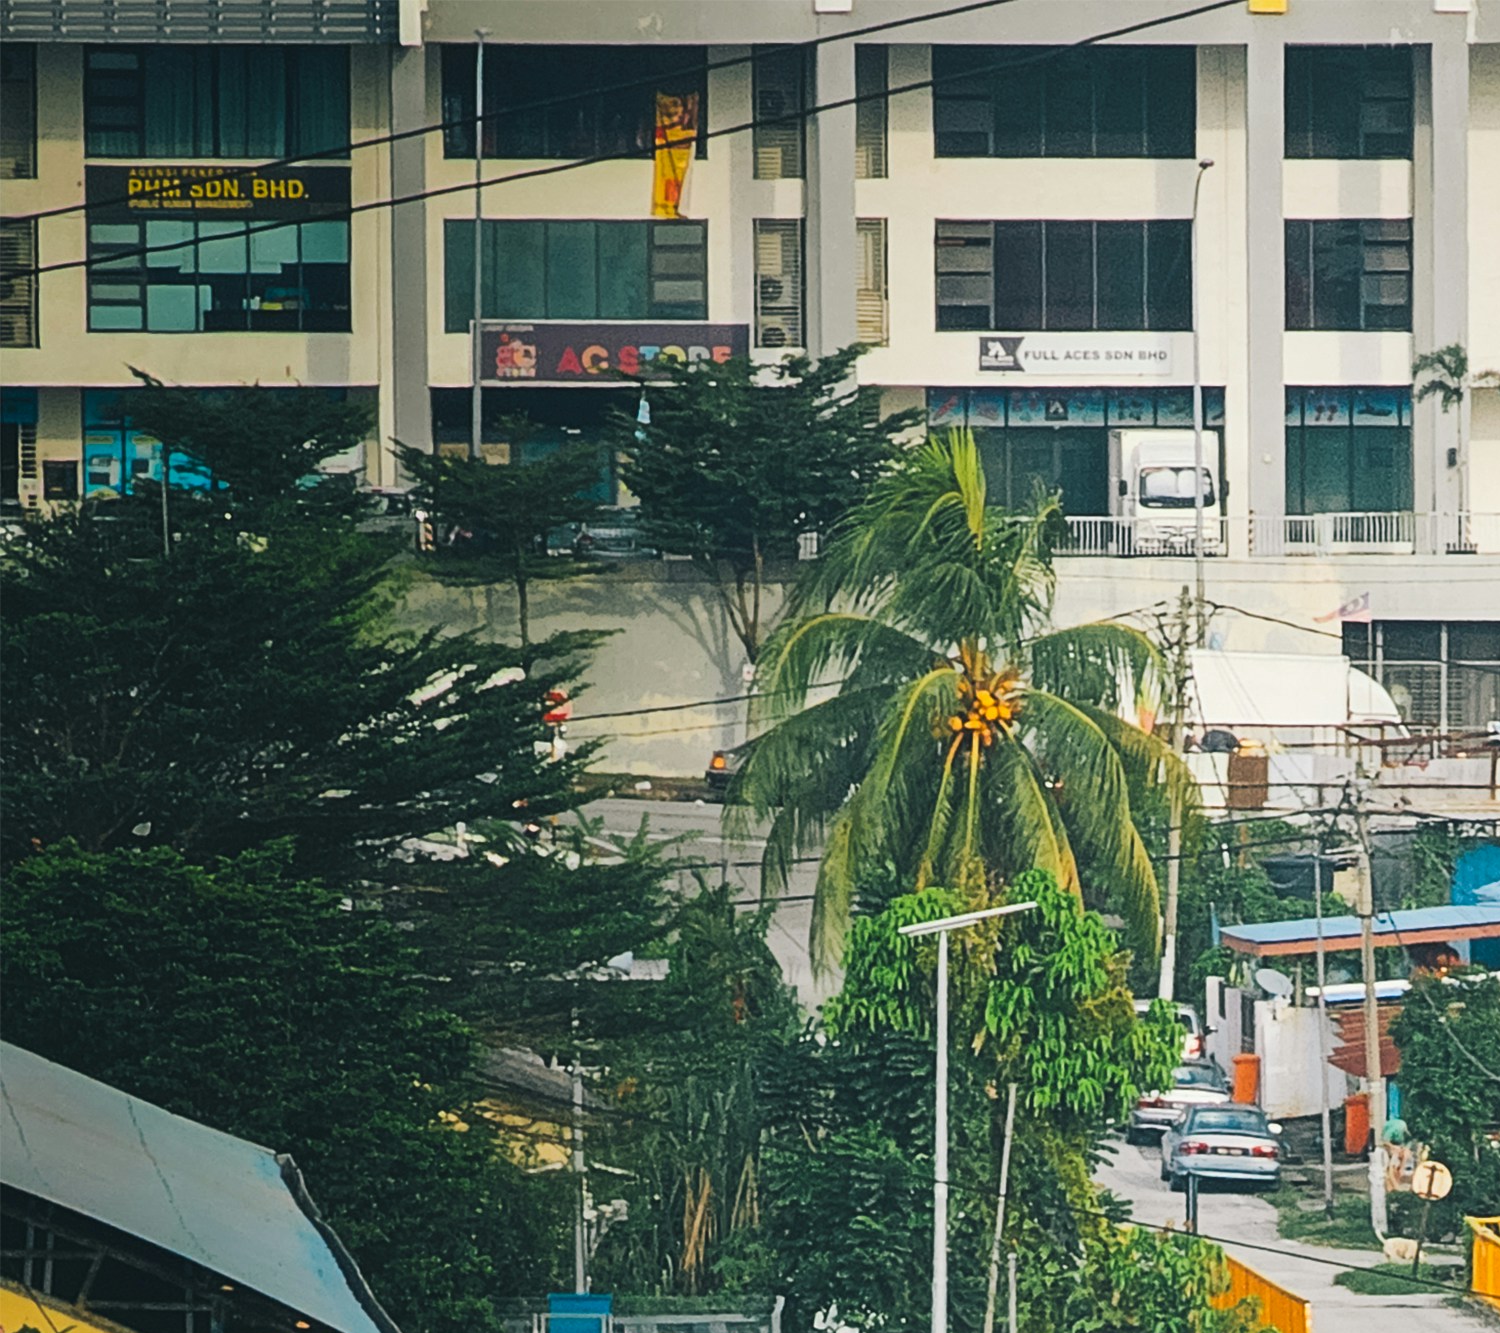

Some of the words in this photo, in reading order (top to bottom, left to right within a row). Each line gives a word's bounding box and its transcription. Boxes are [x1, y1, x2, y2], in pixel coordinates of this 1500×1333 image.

[252, 178, 309, 199] BHD.
[1024, 350, 1059, 361] FULL
[1063, 350, 1100, 361] ACES
[1105, 350, 1133, 361] SDN
[1138, 350, 1167, 361] BHD
